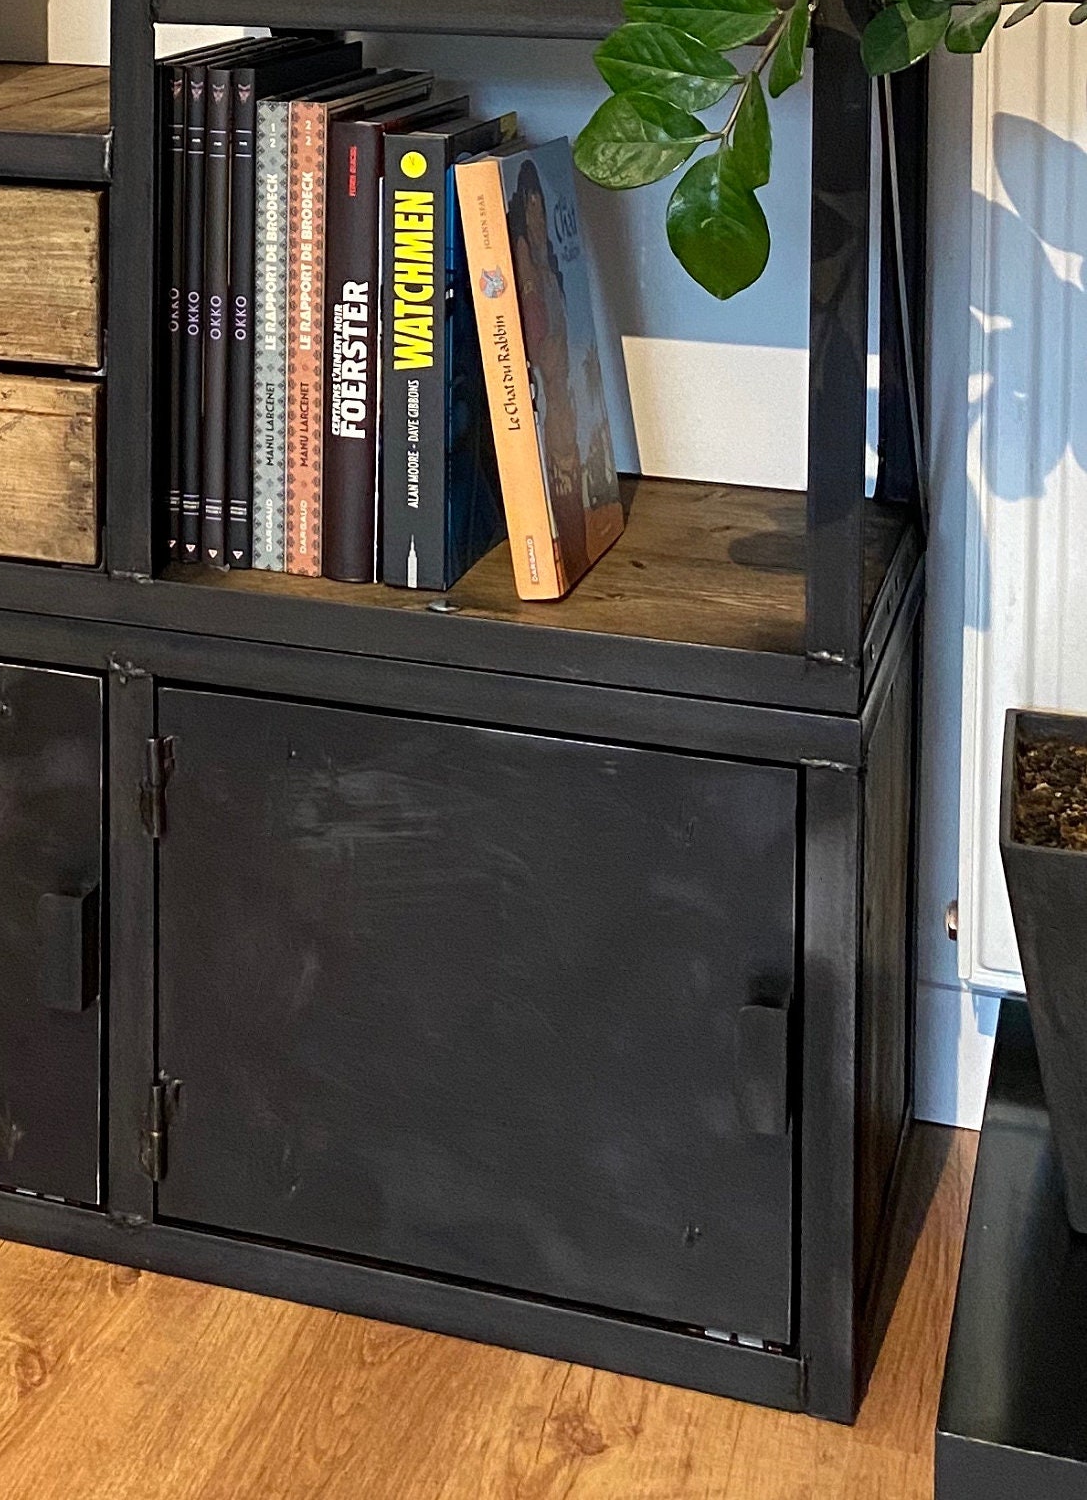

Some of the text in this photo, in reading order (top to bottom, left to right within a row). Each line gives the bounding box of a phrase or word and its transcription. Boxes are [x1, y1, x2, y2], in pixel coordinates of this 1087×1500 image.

[265, 173, 278, 350] LE RAPPORT DE BRODECK
[300, 171, 313, 350] LE RAPPORT DE BRODECK
[477, 194, 492, 250] JOANN SFAR
[188, 291, 200, 336] OKKO
[210, 295, 222, 340] OKKO
[235, 295, 247, 340] OKKO
[393, 191, 434, 370] WATCHMEN
[331, 304, 342, 436] CERTAINS L'AIMENT NOIR
[340, 282, 369, 440] FOERSTER
[493, 315, 521, 431] Le Chat du Rabbin
[265, 381, 275, 466] MANU LARCENET
[299, 381, 309, 467] MANU LARCENET
[407, 380, 420, 508] ALAN MOORE DAVE GIBBONS
[265, 499, 273, 552] DARGAUD
[299, 499, 307, 554] DARGAUD
[527, 538, 538, 582] DARGAUD
